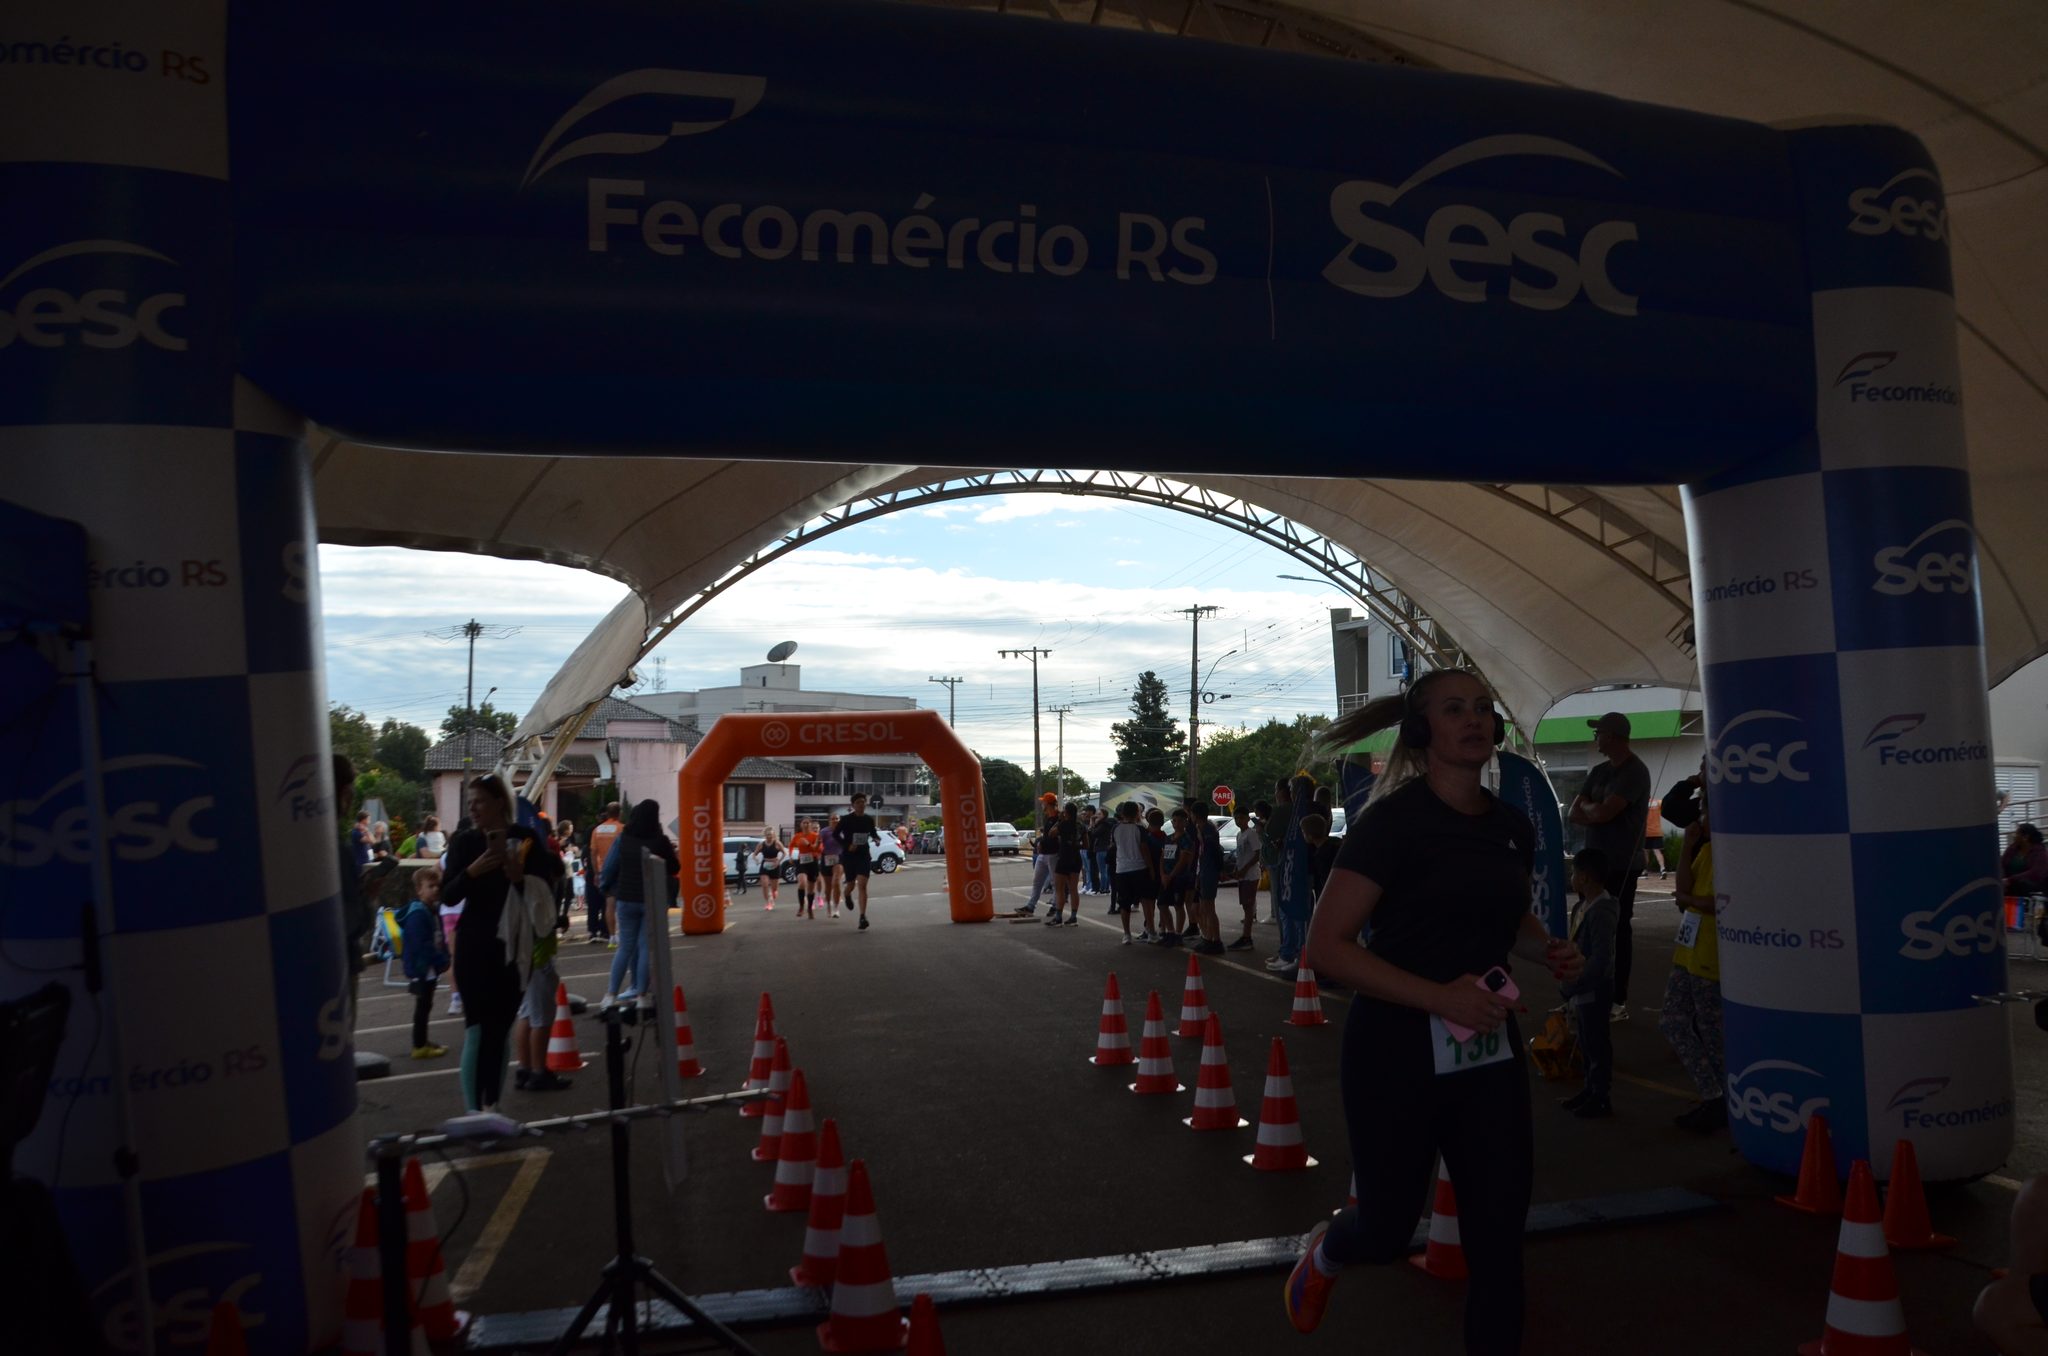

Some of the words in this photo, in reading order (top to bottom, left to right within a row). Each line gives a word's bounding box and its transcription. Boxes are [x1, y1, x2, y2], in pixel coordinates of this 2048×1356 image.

[0, 36, 148, 73] mércio
[161, 50, 209, 85] RS
[587, 176, 1089, 277] Fecomércio
[1117, 211, 1218, 285] RS
[1320, 178, 1639, 317] Sesc
[181, 560, 227, 587] RS
[1784, 569, 1818, 591] RS
[1871, 546, 1976, 596] Ses
[799, 721, 904, 743] CRESOL
[1214, 792, 1232, 800] PARE
[693, 798, 712, 887] CRESOL
[961, 785, 982, 873] CRESOL
[1530, 864, 1551, 935] esc
[1809, 929, 1845, 949] RS
[1898, 910, 2003, 960] Ses
[223, 1045, 268, 1078] RS
